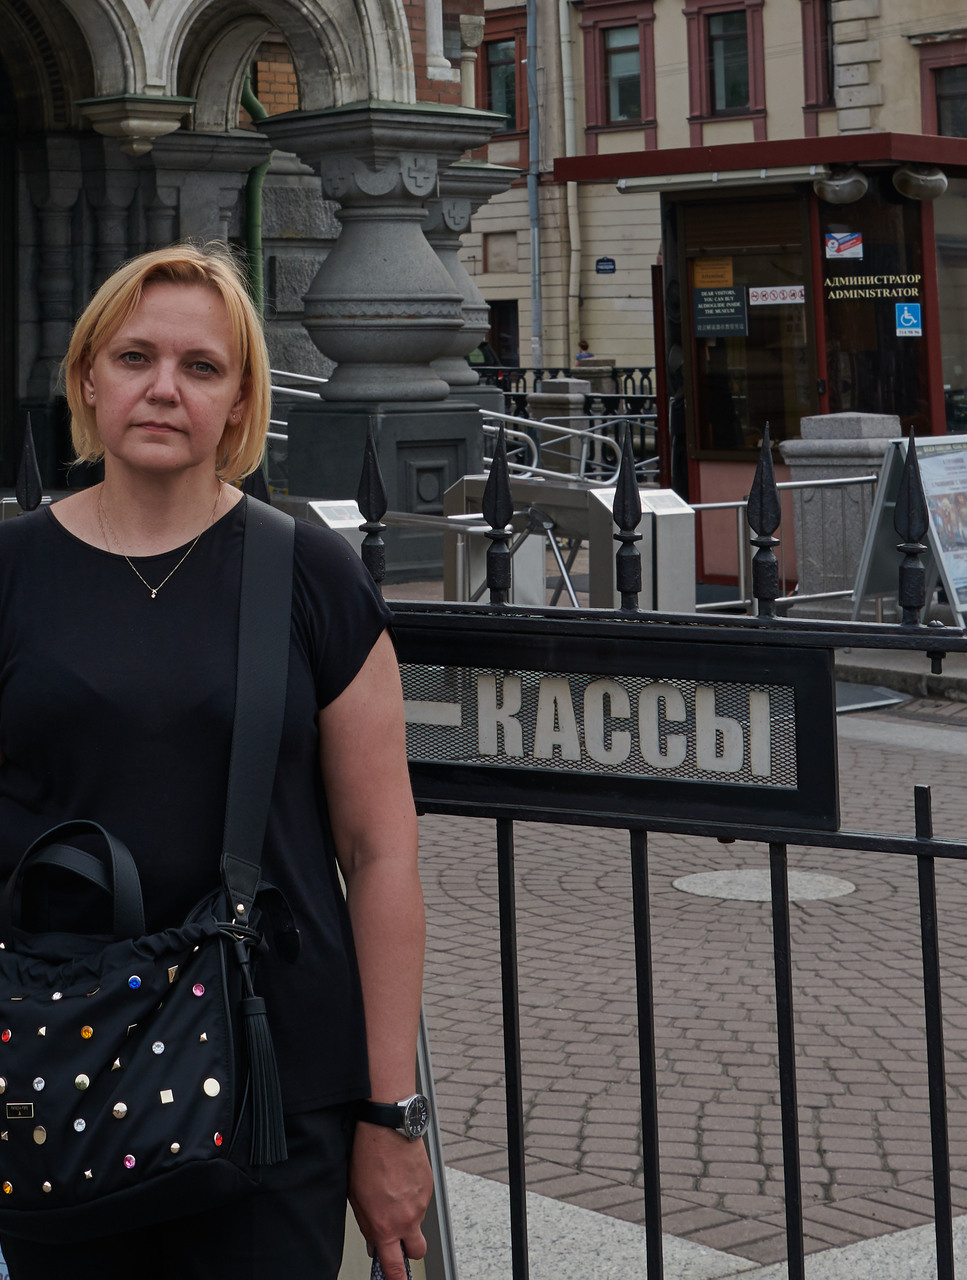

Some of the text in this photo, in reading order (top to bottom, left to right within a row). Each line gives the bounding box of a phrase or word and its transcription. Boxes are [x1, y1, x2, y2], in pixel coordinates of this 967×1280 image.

[824, 274, 921, 287] АДМИНИСТРАТОР
[827, 288, 919, 299] ADMINISTRATOR
[476, 673, 772, 777] КАССЫ
